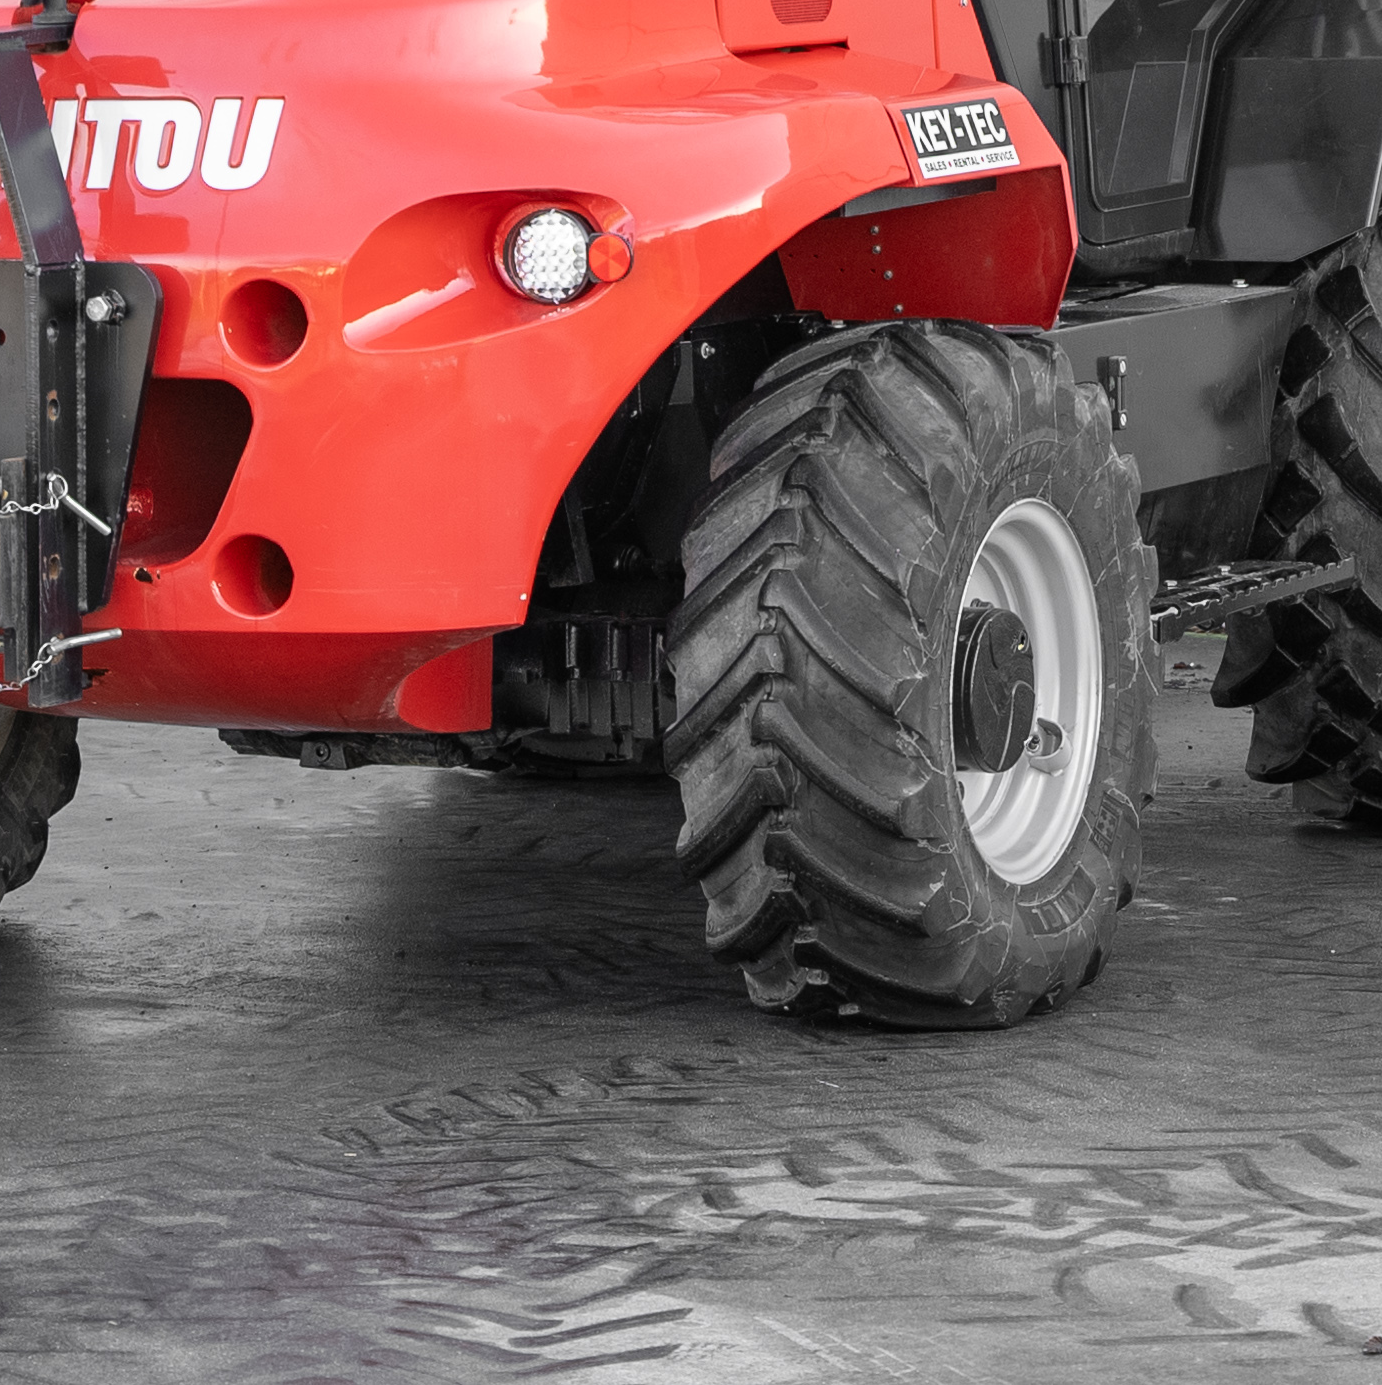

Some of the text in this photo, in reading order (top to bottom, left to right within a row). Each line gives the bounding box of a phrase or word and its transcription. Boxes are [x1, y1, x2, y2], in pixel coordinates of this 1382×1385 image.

[905, 102, 1007, 154] KEY-TEC
[924, 150, 1015, 173] SALES RENTAL SERVICE
